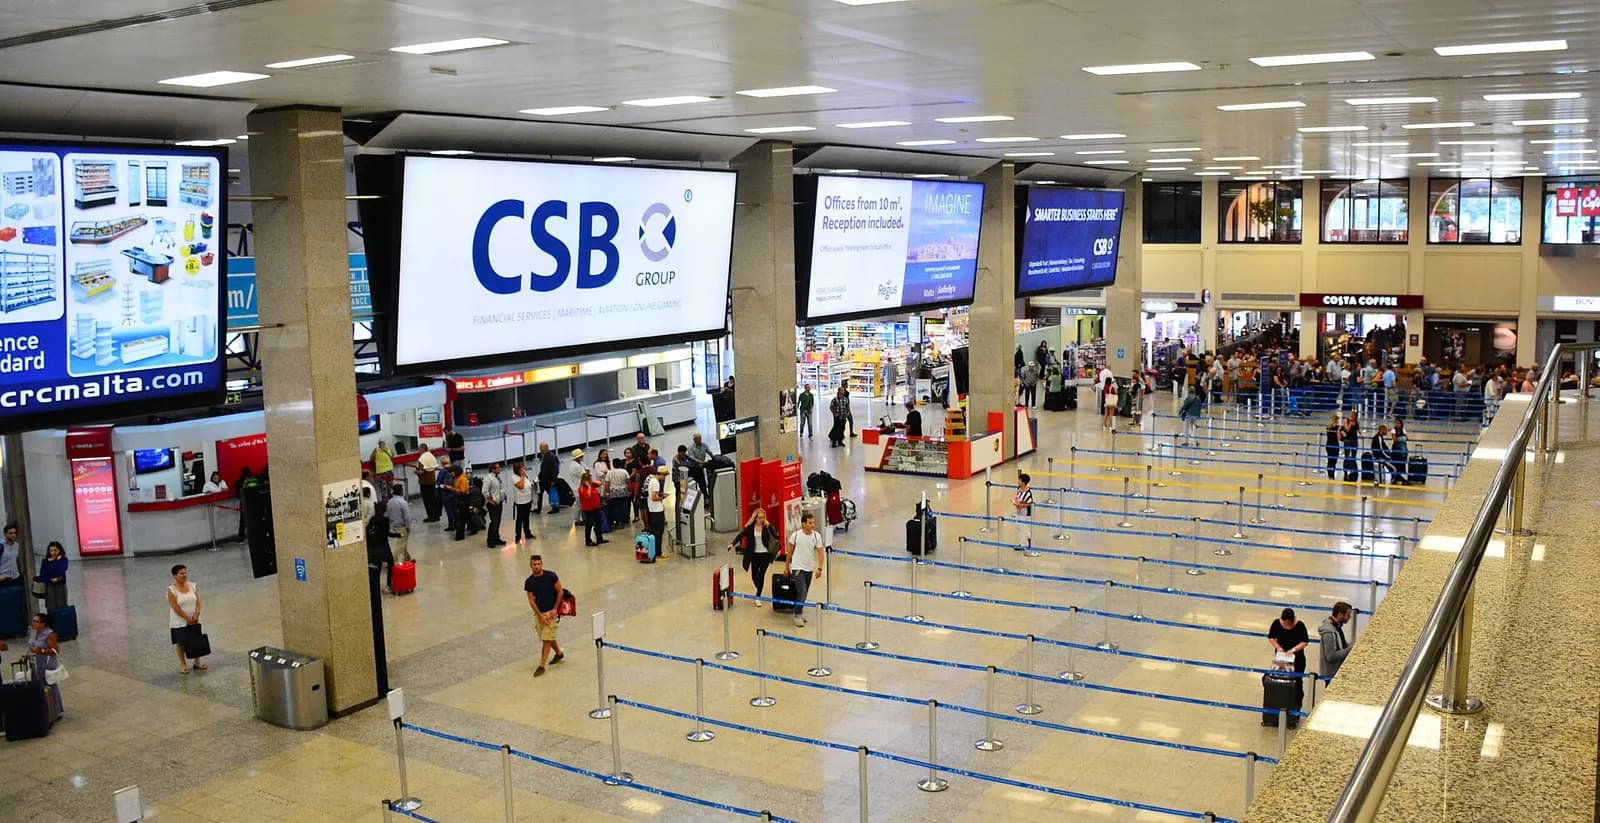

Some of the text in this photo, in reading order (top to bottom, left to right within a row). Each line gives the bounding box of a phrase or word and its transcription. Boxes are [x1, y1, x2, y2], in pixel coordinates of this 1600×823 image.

[824, 195, 856, 210] Offices
[857, 196, 878, 211] from
[879, 197, 889, 211] 10
[925, 193, 972, 215] IMAGINE
[822, 215, 904, 233] Reception included.
[1034, 208, 1061, 222] SMARTER
[1061, 208, 1087, 221] BUSINESS
[1087, 208, 1104, 221] STARTS
[472, 198, 620, 295] CSB
[1093, 238, 1108, 256] CSB
[635, 270, 676, 287] GROUP
[878, 284, 898, 301] Regus
[1322, 295, 1398, 306] COSTA COFFEE
[472, 313, 516, 325] FINANCIAL
[516, 309, 552, 322] SERVICES
[556, 305, 593, 319] MARITIME
[0, 370, 204, 408] crcmalta.com
